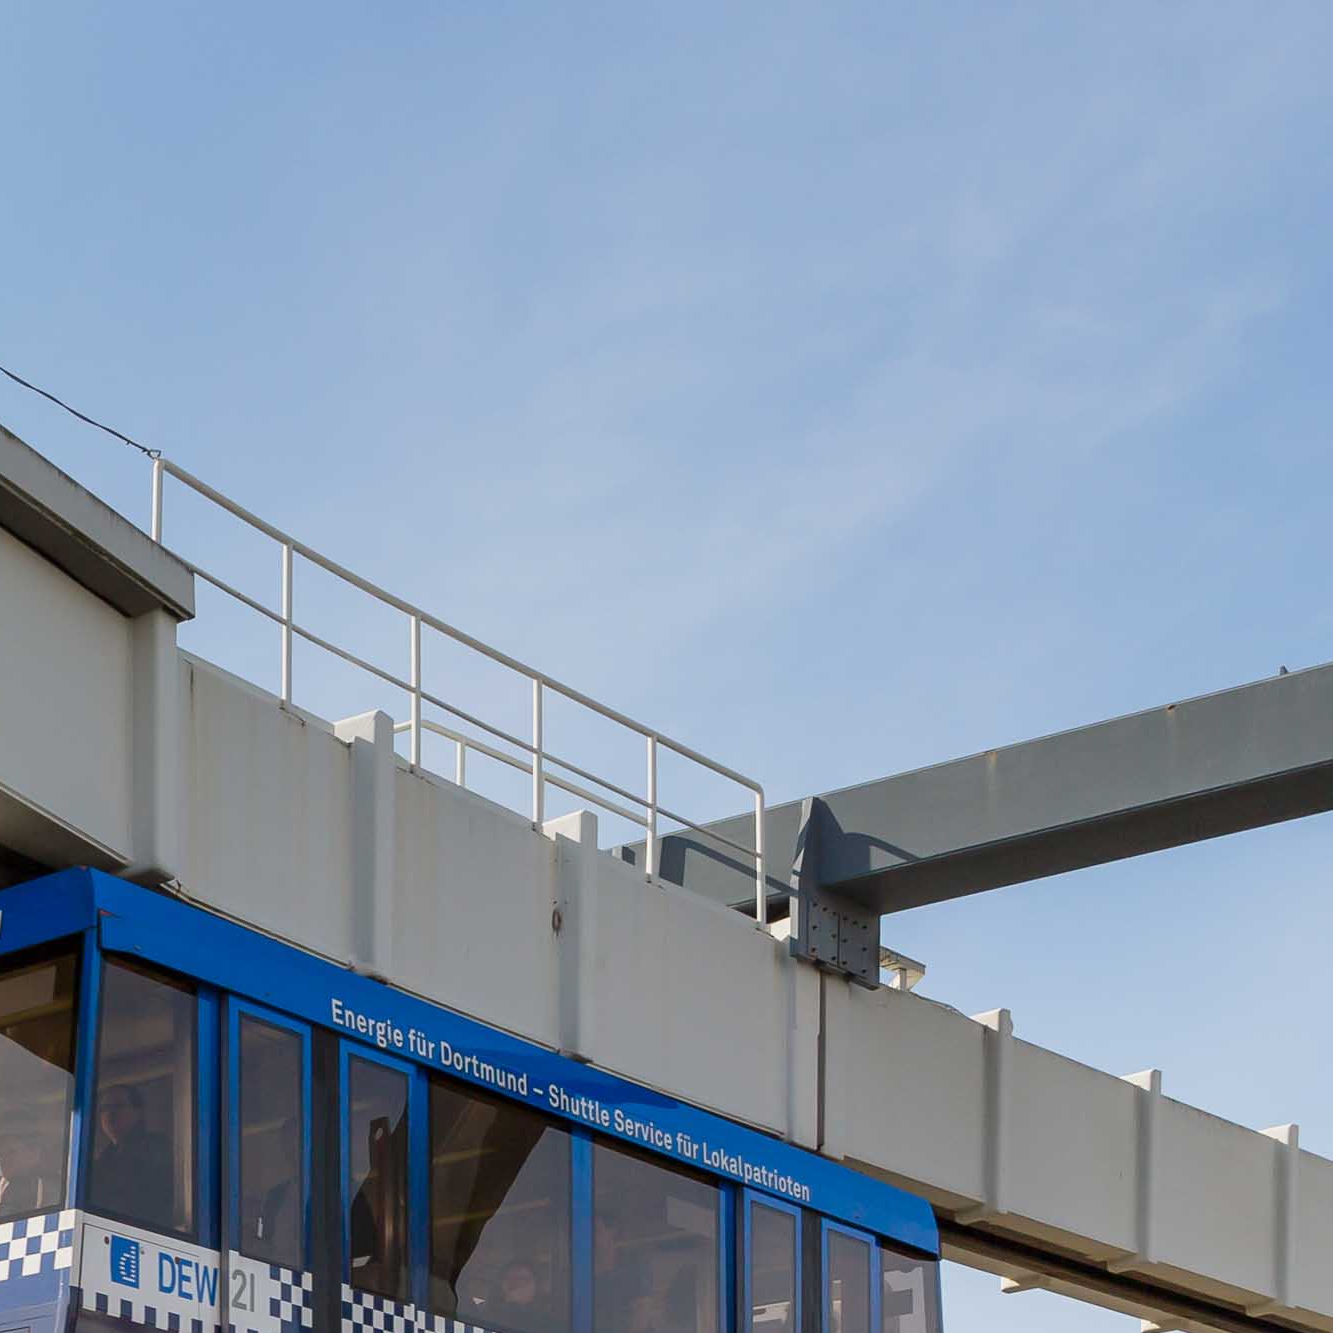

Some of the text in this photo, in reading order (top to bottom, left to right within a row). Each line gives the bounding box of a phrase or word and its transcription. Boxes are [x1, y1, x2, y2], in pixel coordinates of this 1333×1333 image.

[331, 998, 404, 1048] Energie
[408, 1028, 435, 1059] für
[440, 1041, 528, 1096] Dortmund
[548, 1084, 610, 1127] Shuttle
[614, 1109, 673, 1150] Service
[676, 1132, 699, 1159] für
[702, 1142, 810, 1201] Lokalpatrioten
